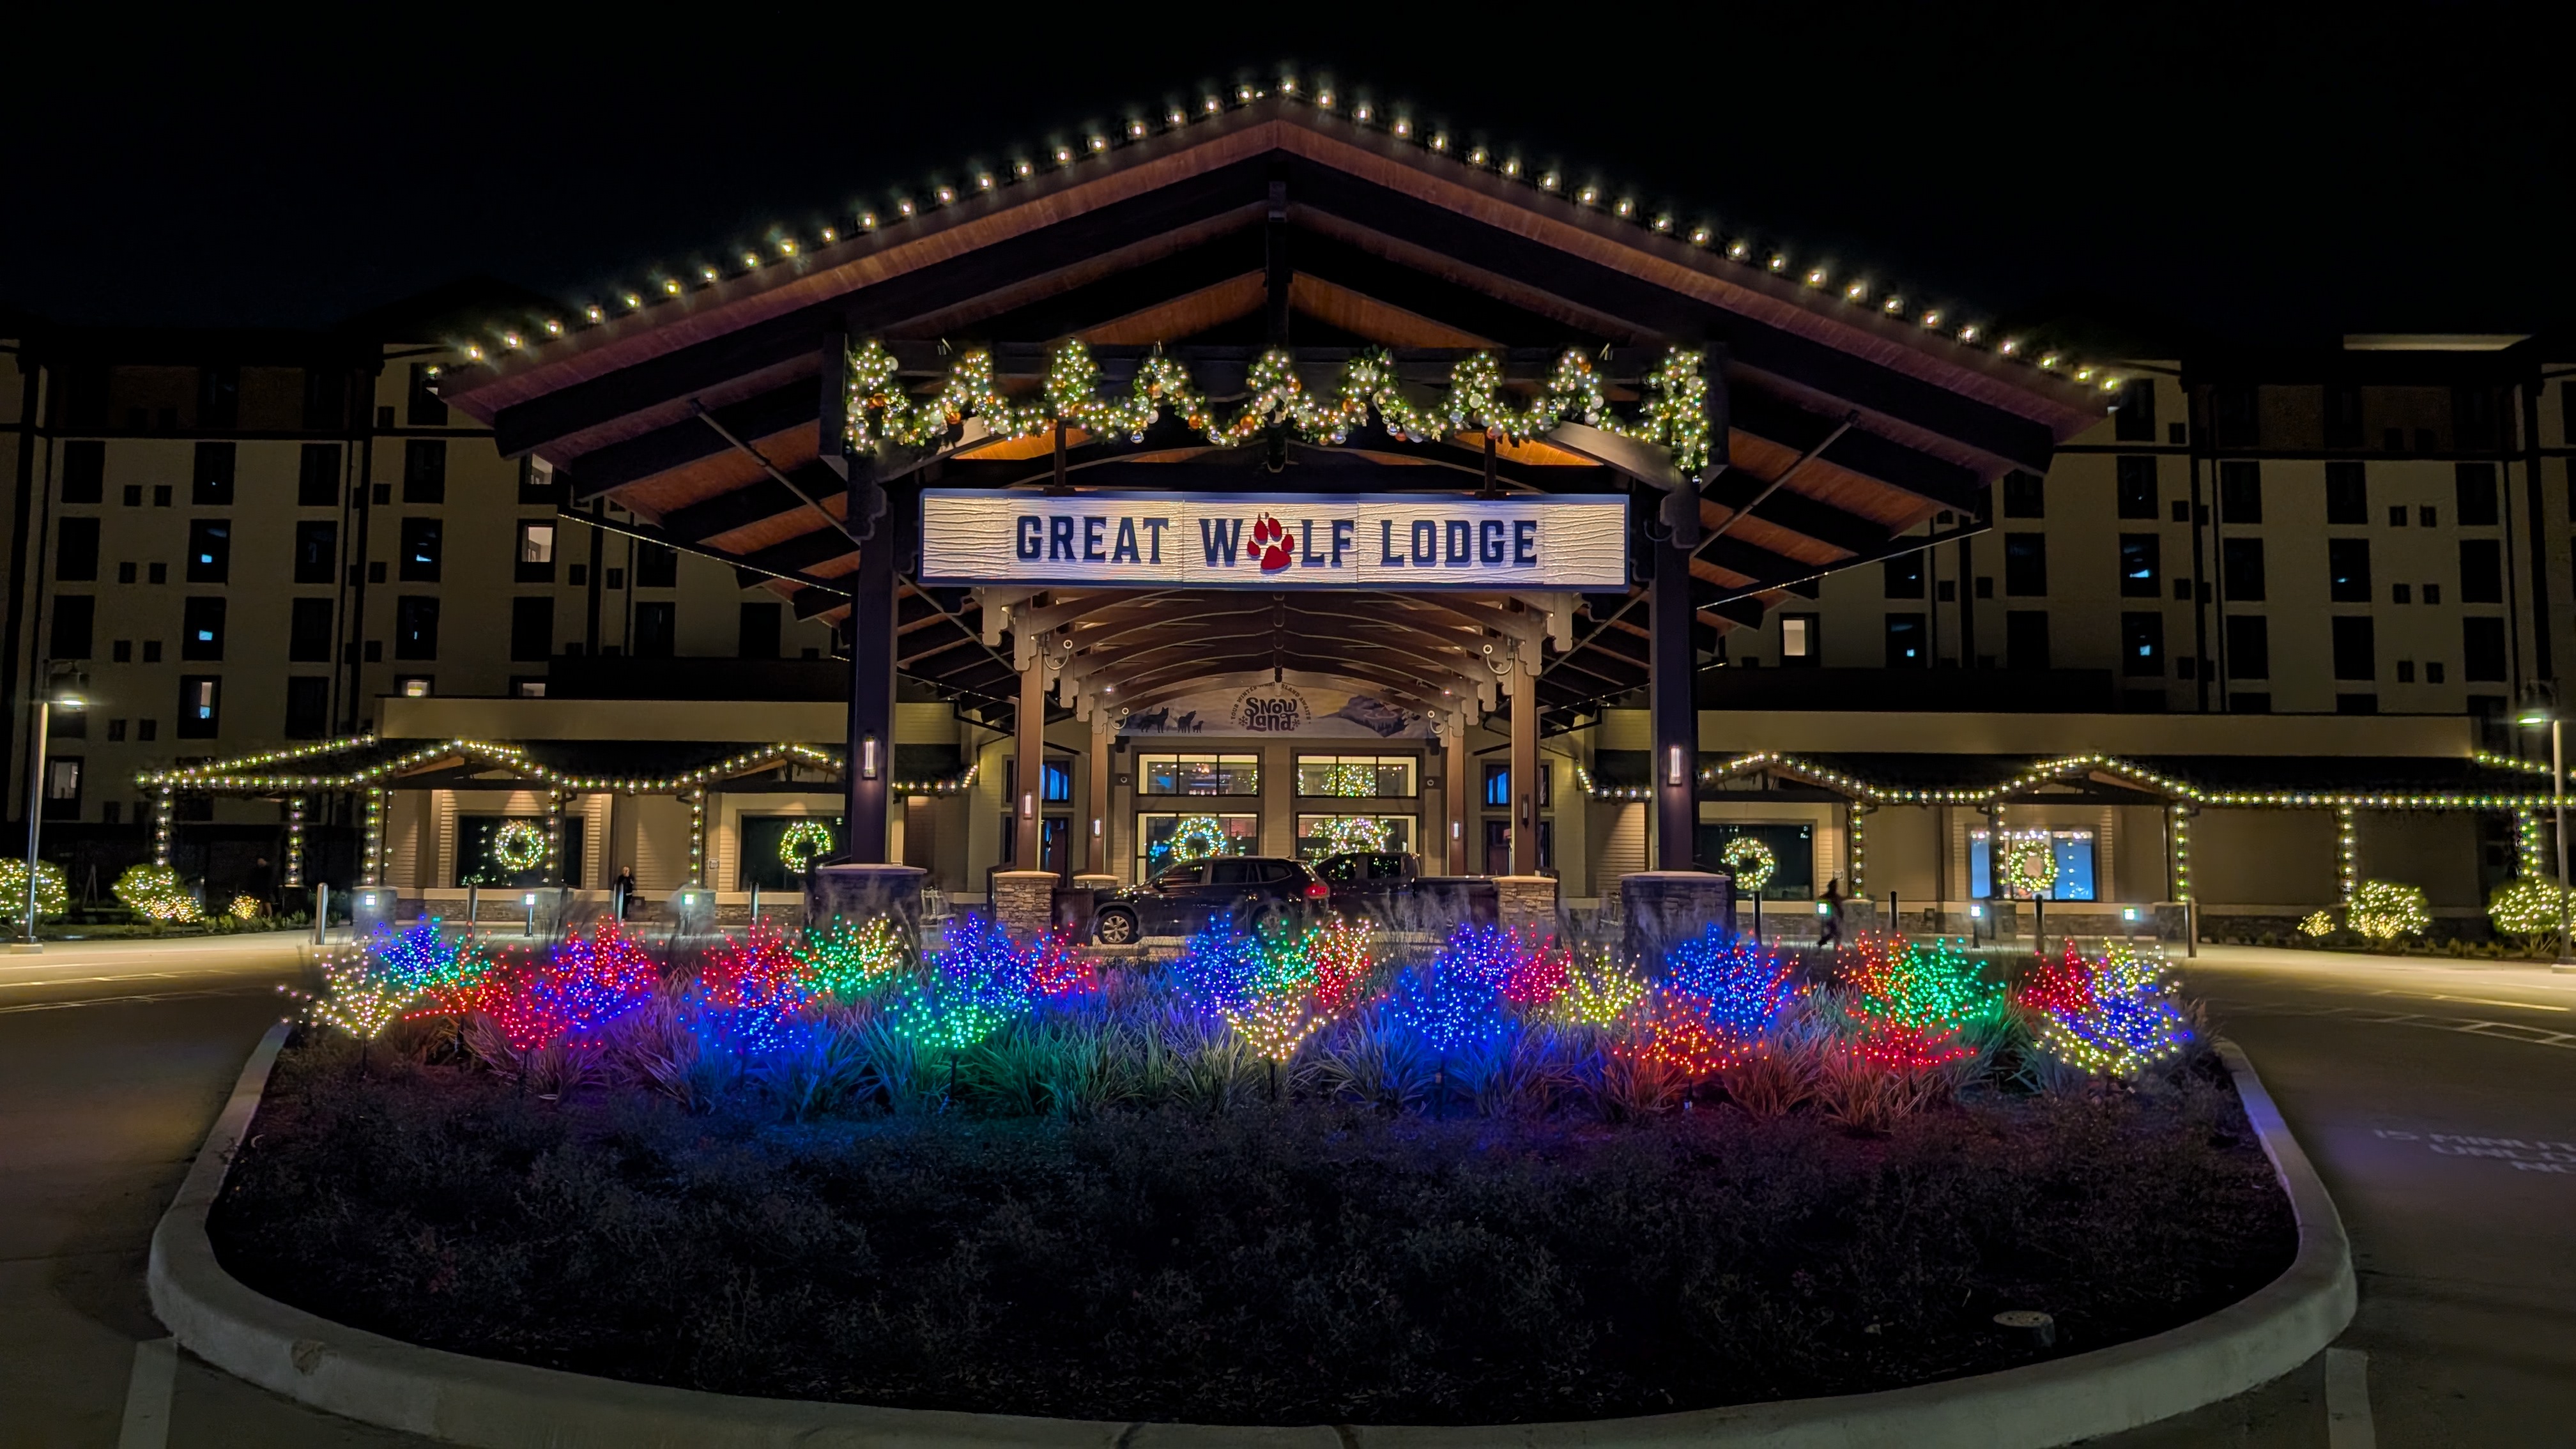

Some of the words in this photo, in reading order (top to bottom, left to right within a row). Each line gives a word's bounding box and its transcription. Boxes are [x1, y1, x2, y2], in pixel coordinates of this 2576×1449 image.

[1016, 516, 1169, 564] GREAT
[1380, 519, 1537, 567] LODGE
[1230, 703, 1239, 719] YOUR
